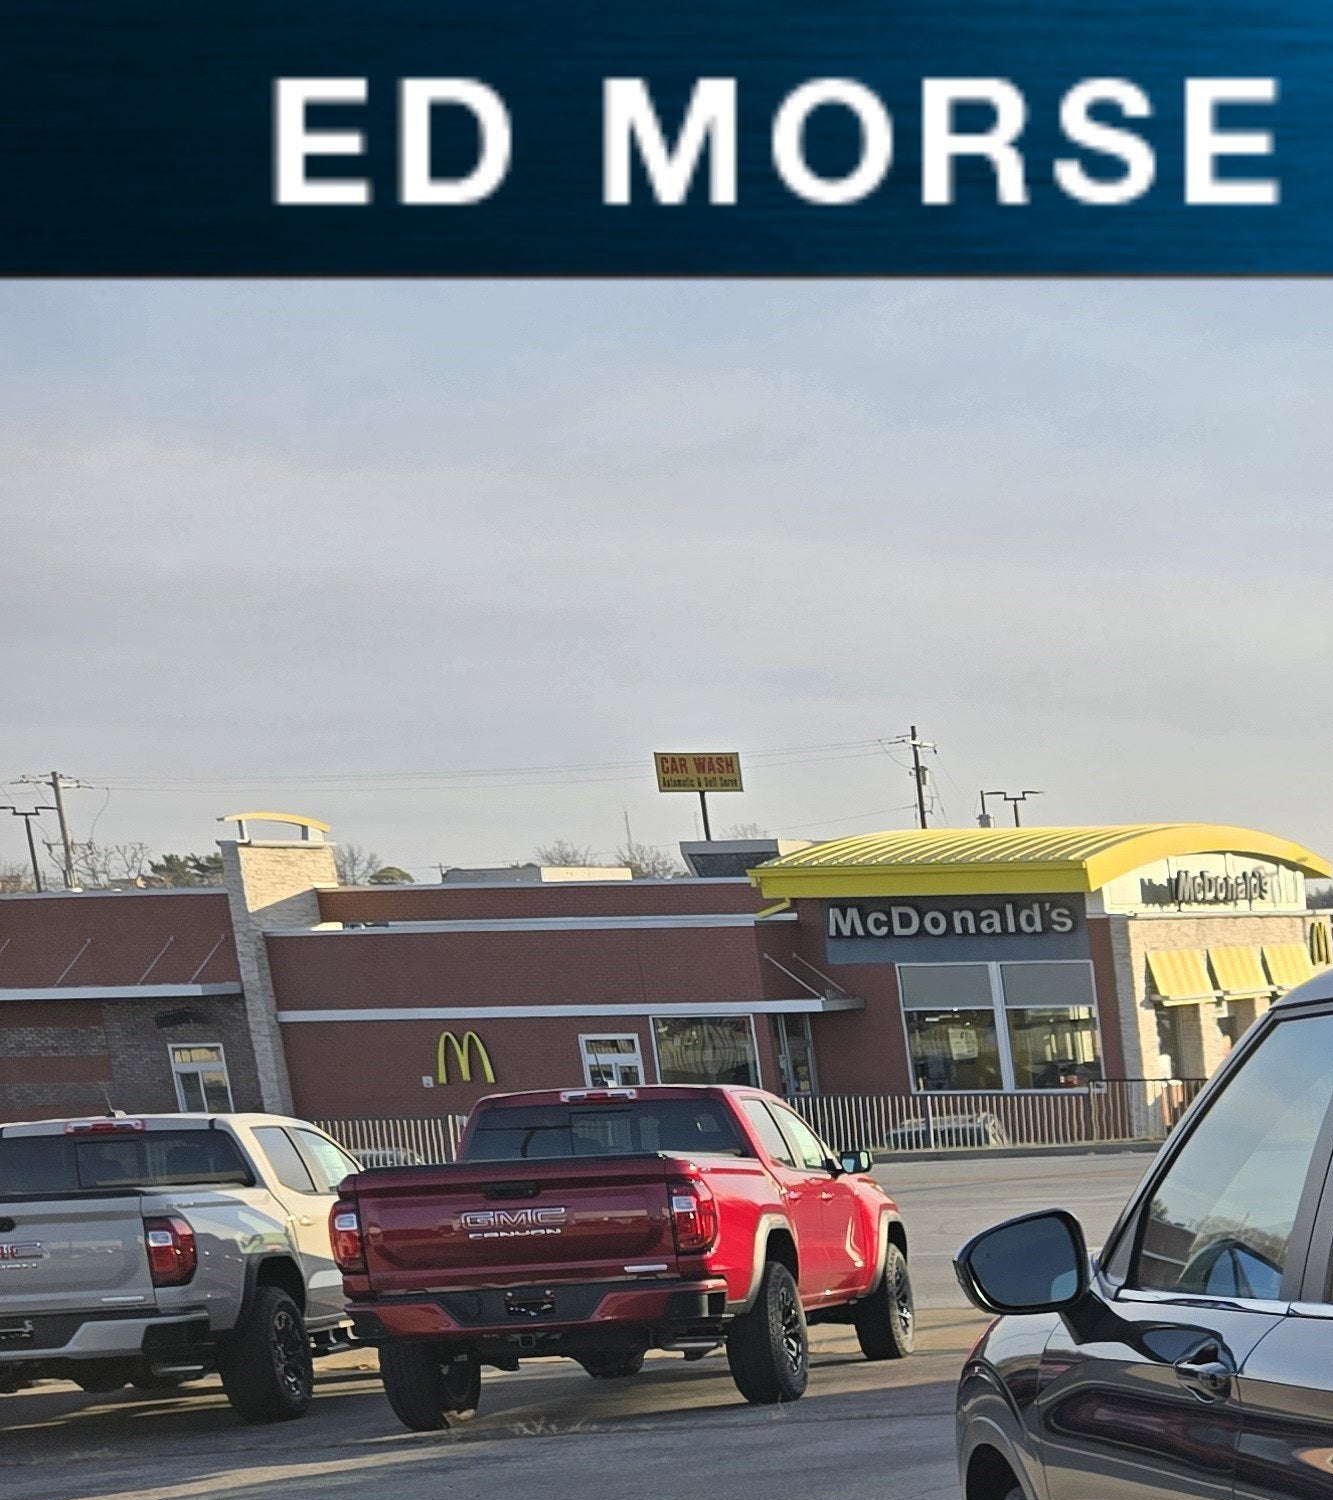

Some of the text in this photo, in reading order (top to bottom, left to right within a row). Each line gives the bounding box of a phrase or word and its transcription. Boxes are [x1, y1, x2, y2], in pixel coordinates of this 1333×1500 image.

[660, 757, 735, 774] CAR WASH
[662, 777, 694, 787] Automatic
[704, 777, 718, 787] Self
[720, 777, 738, 787] Serve
[828, 903, 1074, 937] McDonald's
[461, 1207, 565, 1229] GMC
